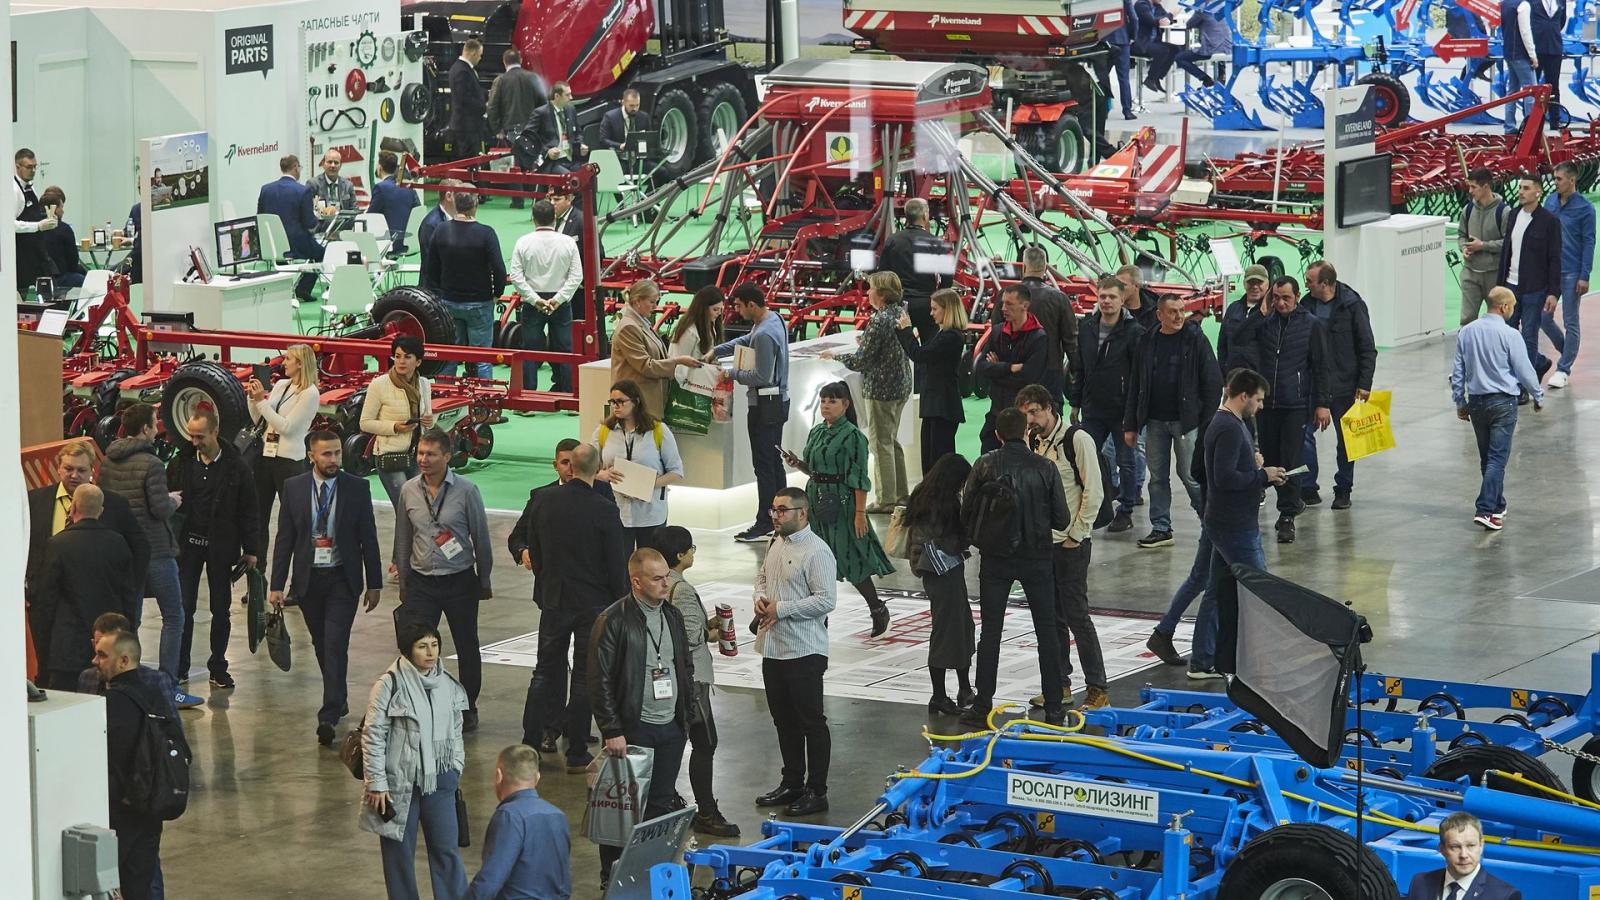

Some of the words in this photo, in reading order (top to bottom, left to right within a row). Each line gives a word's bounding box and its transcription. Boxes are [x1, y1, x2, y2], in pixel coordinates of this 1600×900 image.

[301, 15, 350, 31] ЗАПАСНЫЕ
[351, 11, 380, 26] ЧАСТИ
[940, 16, 982, 25] Kverneland
[230, 32, 269, 48] ORIGINAL
[231, 46, 269, 65] PARTS
[820, 99, 867, 109] Kverand
[237, 141, 279, 157] Kverneland
[1049, 187, 1094, 197] Keland
